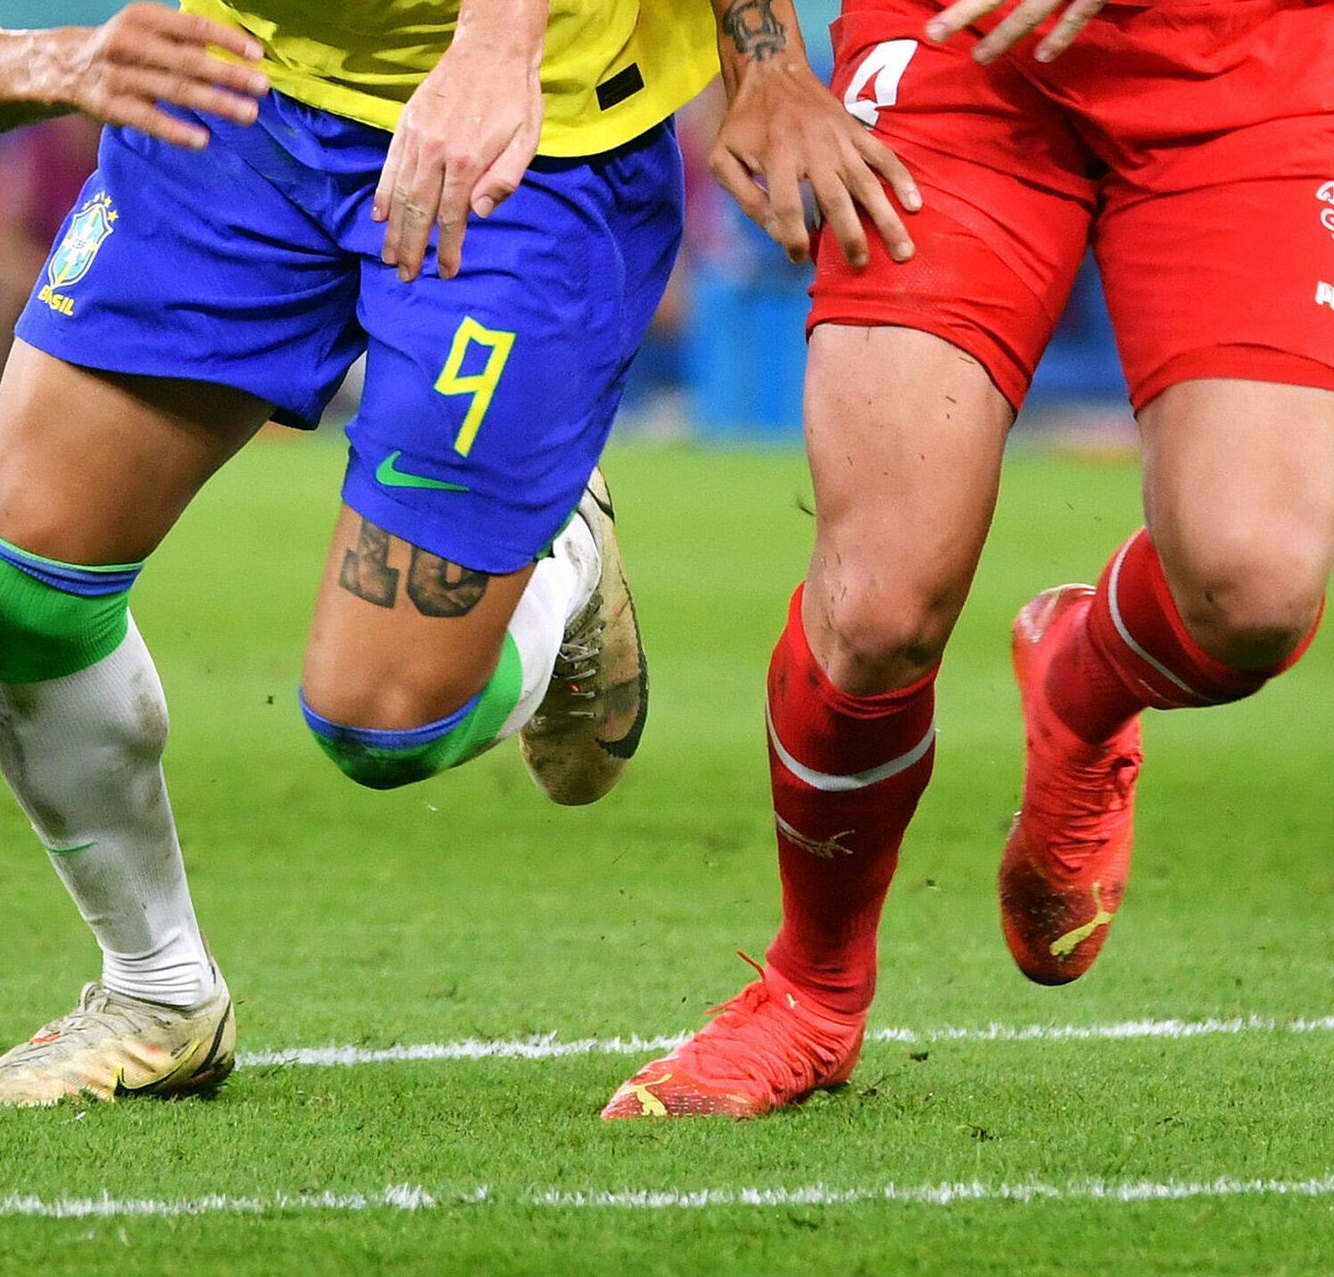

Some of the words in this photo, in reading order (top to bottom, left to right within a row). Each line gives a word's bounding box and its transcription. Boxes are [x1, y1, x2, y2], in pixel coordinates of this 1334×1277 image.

[843, 38, 920, 131] 4
[433, 314, 517, 458] 9
[338, 515, 490, 618] 10
